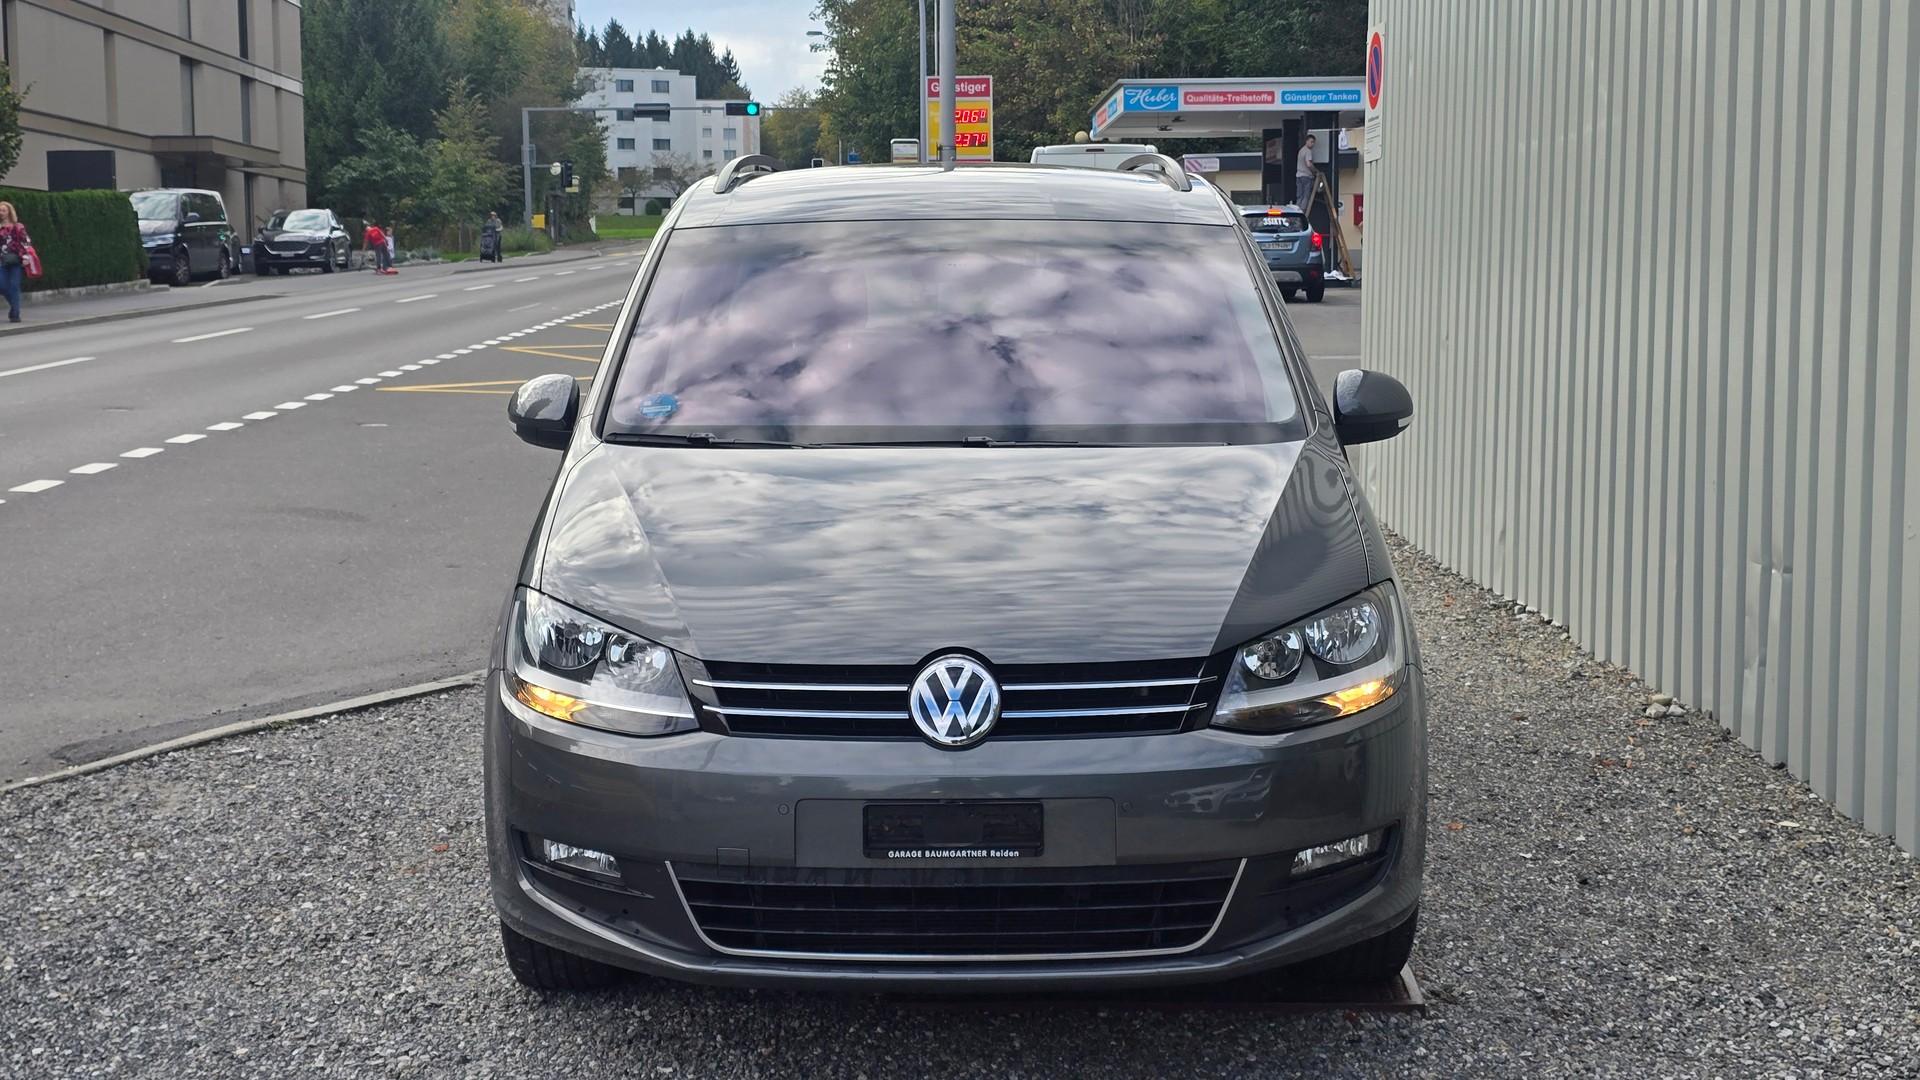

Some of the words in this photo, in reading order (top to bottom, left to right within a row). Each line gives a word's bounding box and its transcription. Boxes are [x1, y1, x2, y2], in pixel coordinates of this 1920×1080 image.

[931, 82, 986, 94] Gstiger
[1125, 88, 1177, 110] Huber
[1186, 93, 1272, 103] Qualitäts-Treibstoffe
[1284, 92, 1326, 103] Günstiger
[1328, 92, 1358, 101] Tanken
[914, 658, 996, 741] VW
[888, 850, 922, 858] GARAGE
[925, 850, 988, 858] BAUMGARTNER
[990, 850, 1020, 858] Reiden
